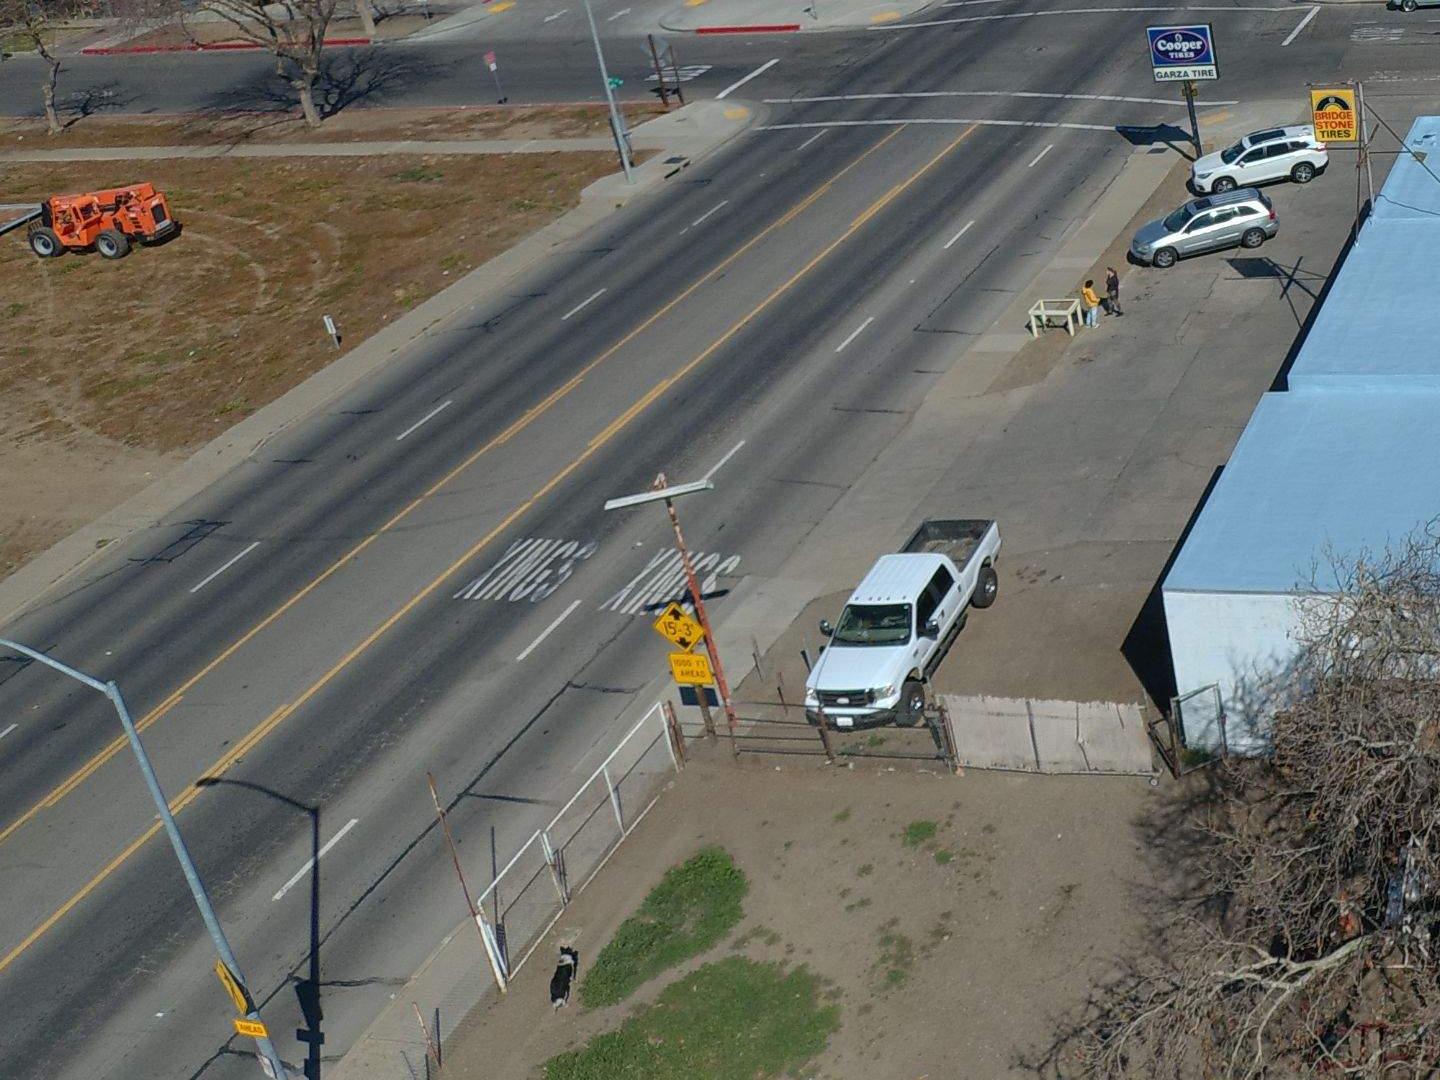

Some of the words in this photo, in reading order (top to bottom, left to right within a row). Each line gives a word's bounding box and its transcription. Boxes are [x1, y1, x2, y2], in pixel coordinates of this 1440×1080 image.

[1157, 40, 1203, 52] Cooper
[1155, 70, 1190, 79] GARZA
[1191, 69, 1215, 78] TIRE
[1314, 111, 1353, 120] BRIDGE
[1315, 121, 1354, 129] STONE
[1319, 130, 1351, 138] TIRES
